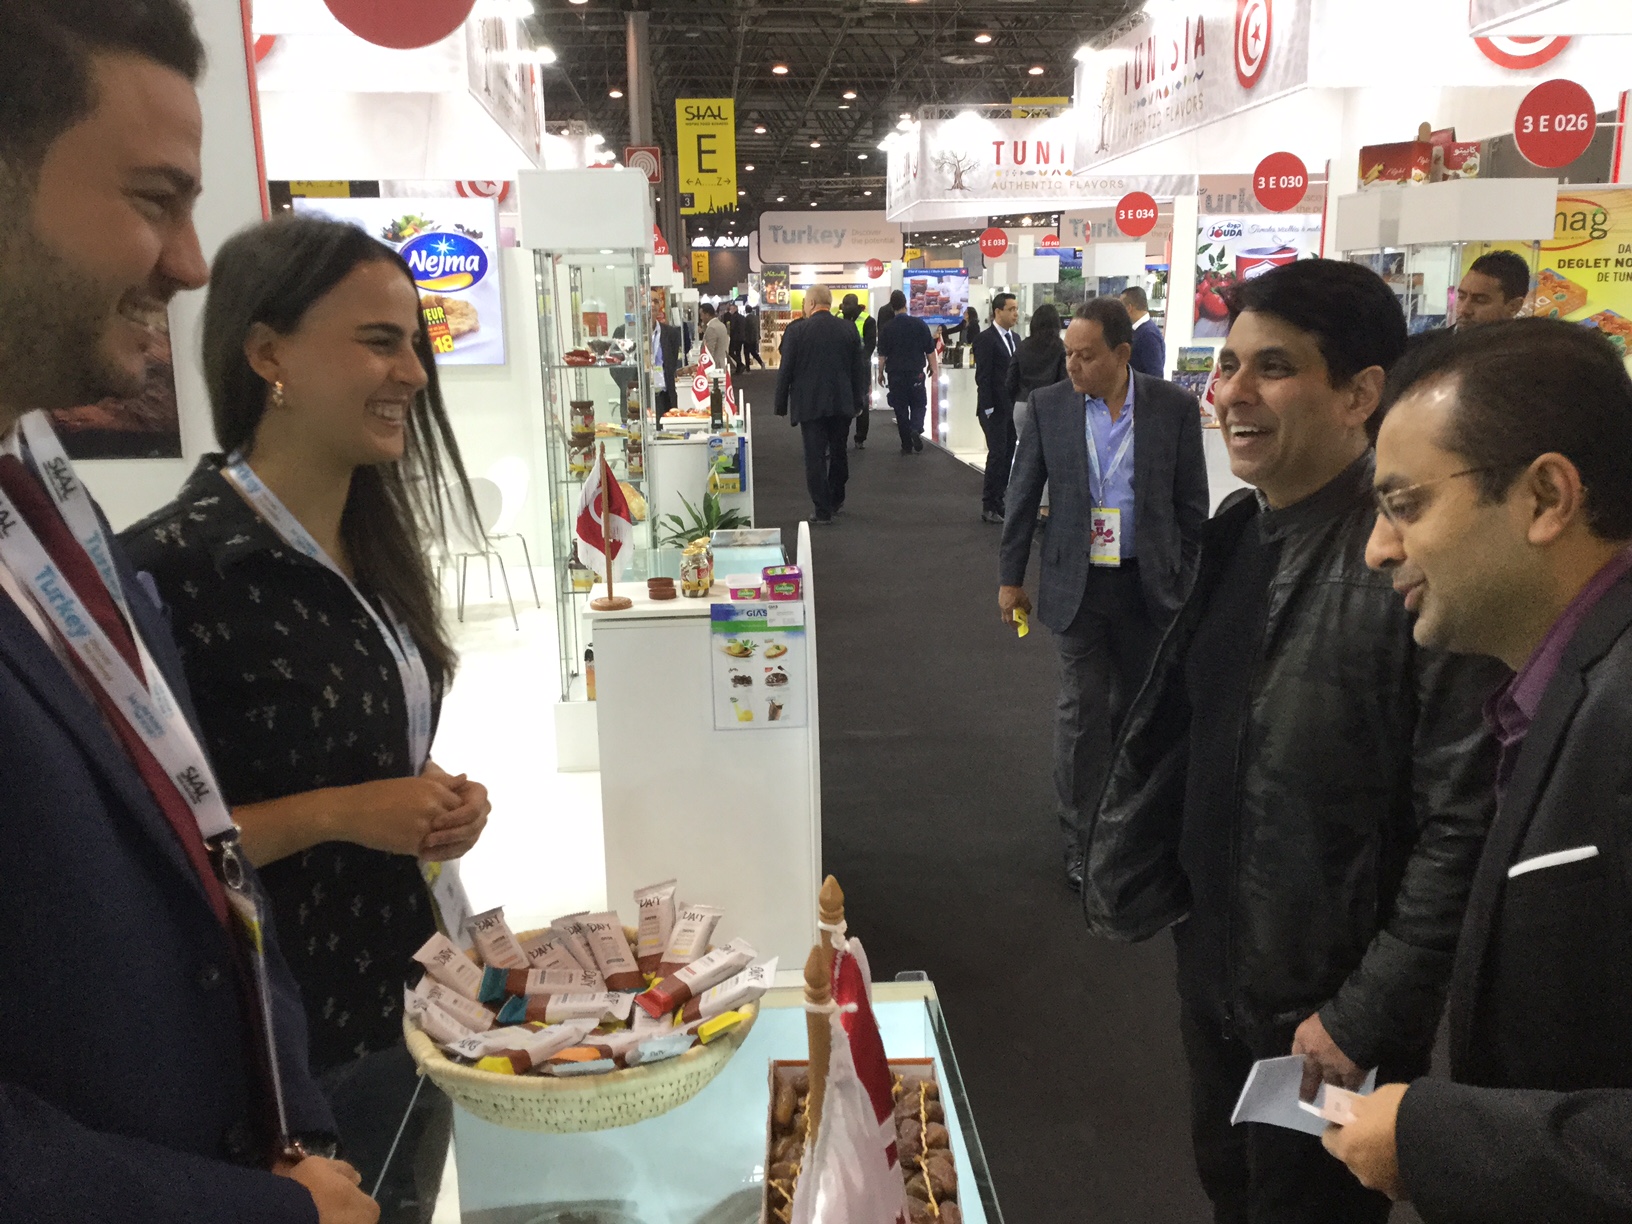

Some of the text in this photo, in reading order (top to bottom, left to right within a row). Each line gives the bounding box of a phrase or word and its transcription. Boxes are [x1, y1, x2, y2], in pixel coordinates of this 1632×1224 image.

[684, 105, 728, 121] SIAL
[1522, 113, 1588, 133] 3 E 026
[696, 134, 717, 173] E
[991, 179, 1124, 190] AUTHENTIC FLAVORS
[1258, 175, 1303, 189] 3 E 030
[684, 197, 691, 207] 3
[1119, 208, 1154, 219] 3 E 034
[768, 225, 847, 248] Turkey
[982, 239, 988, 247] 3
[993, 238, 1006, 246] 038
[408, 249, 480, 277] Nejma
[697, 260, 704, 273] E
[1558, 258, 1611, 269] DEGLET
[1597, 271, 1611, 282] DE
[35, 563, 92, 638] Turkey
